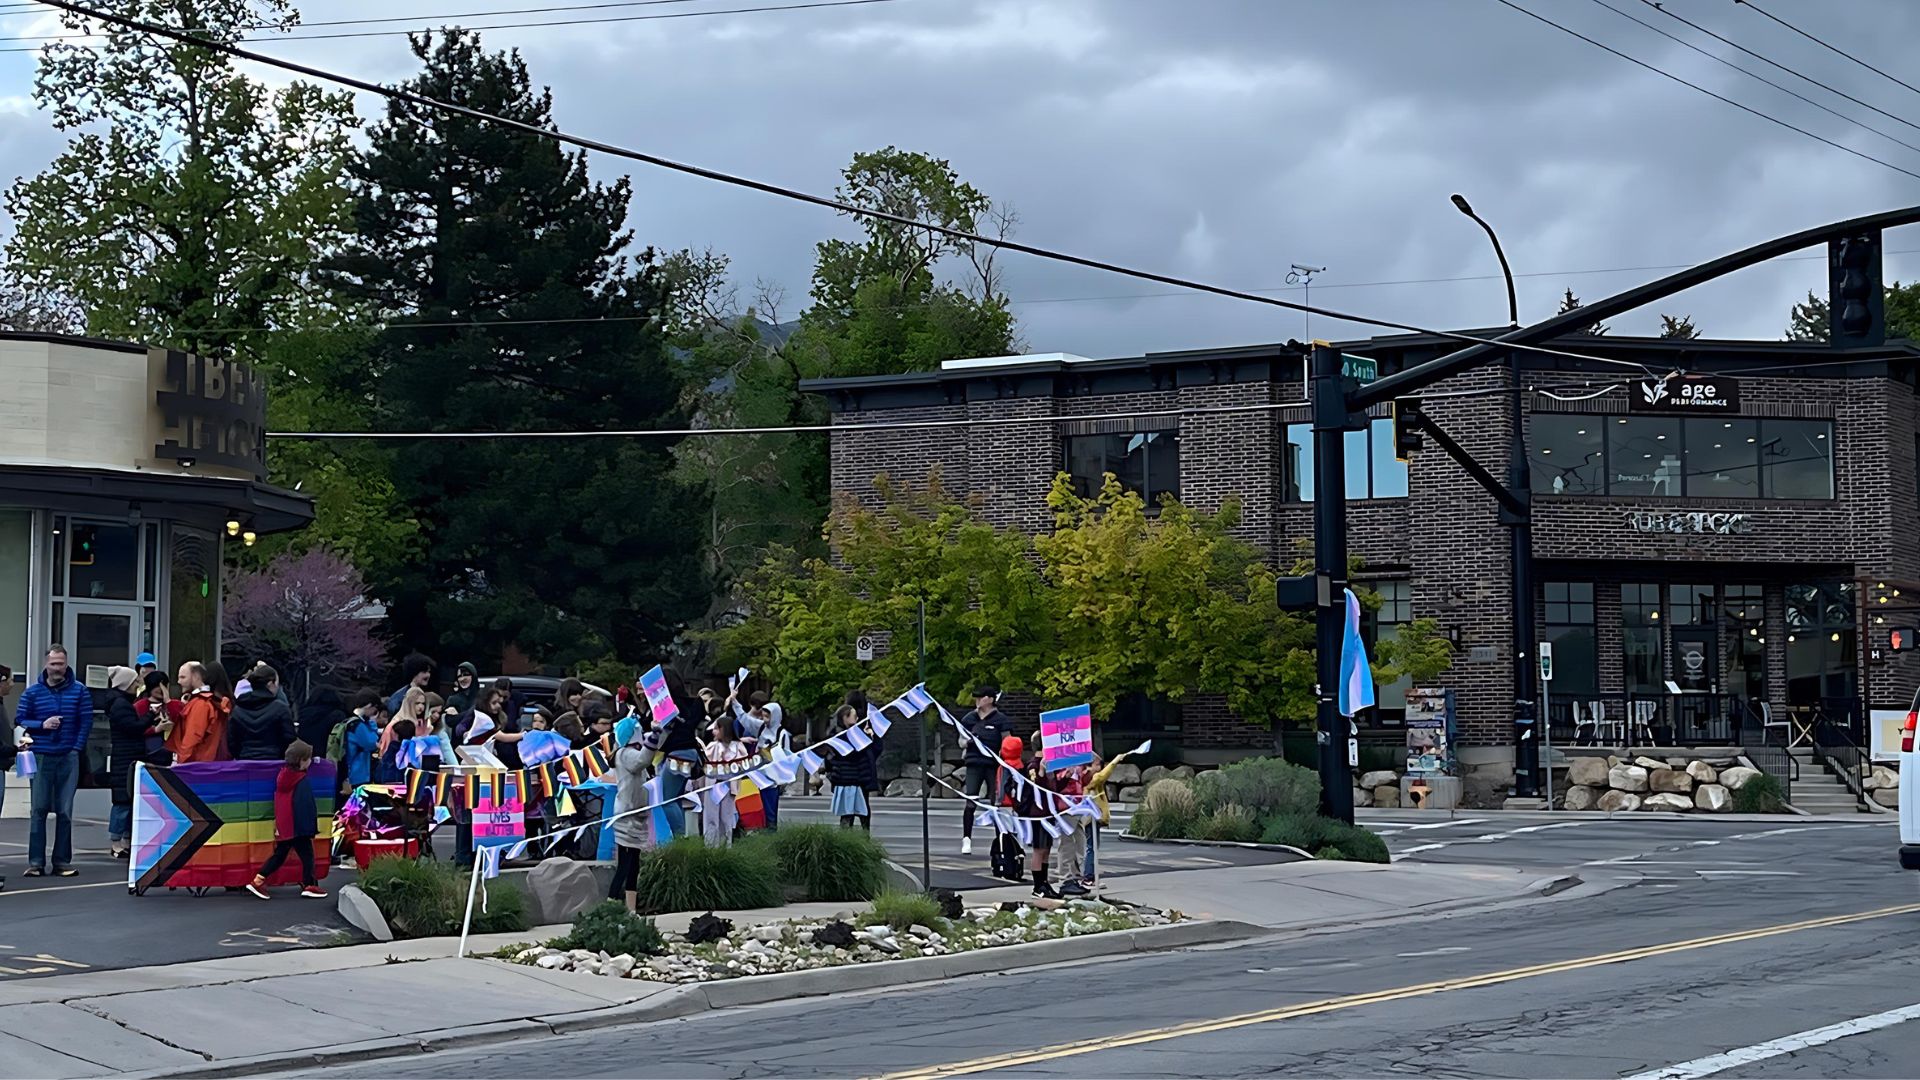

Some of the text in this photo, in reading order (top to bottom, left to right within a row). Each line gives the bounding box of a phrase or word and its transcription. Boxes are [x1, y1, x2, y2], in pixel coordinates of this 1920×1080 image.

[1352, 362, 1375, 380] South
[1681, 384, 1716, 400] age
[1871, 650, 1880, 659] H
[706, 755, 762, 776] PROUD
